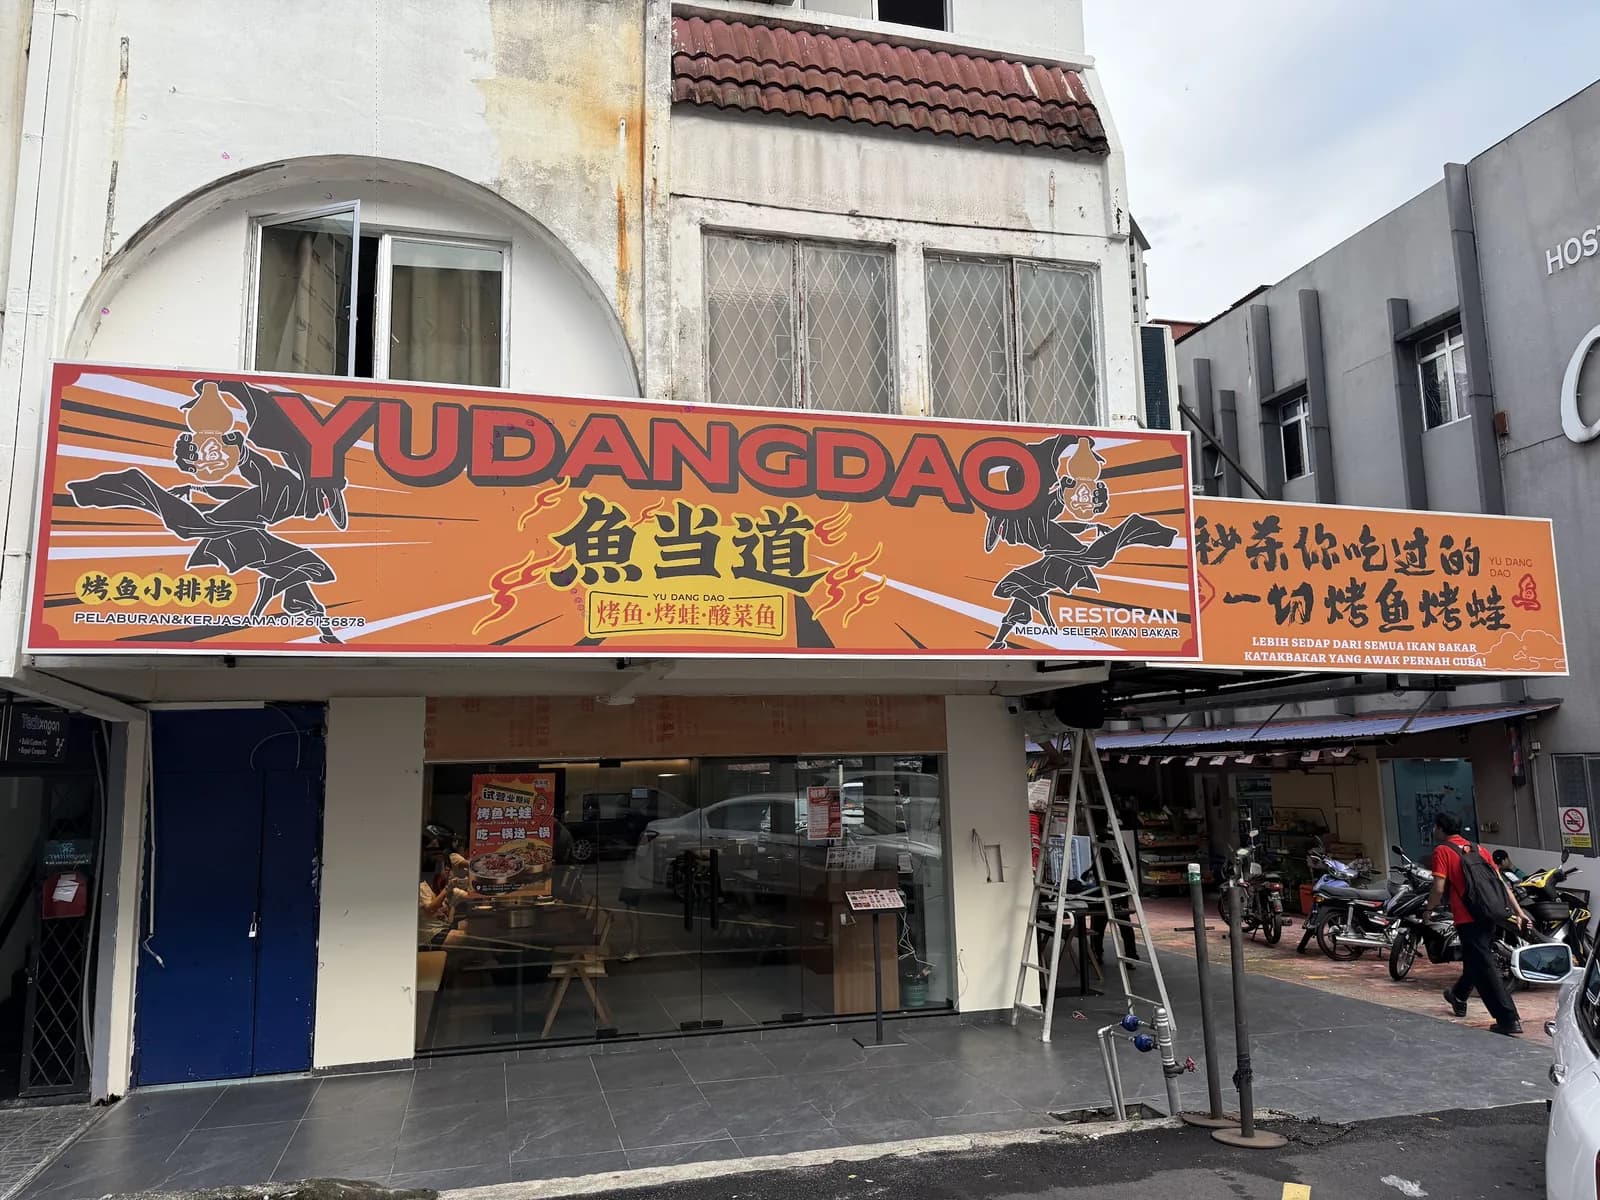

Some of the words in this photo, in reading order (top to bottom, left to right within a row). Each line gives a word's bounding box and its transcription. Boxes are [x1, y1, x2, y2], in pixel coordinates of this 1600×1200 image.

[1545, 225, 1600, 275] HOS
[271, 395, 1042, 513] YUDANGDAO
[1488, 556, 1502, 566] YU
[1504, 558, 1533, 568] DANG
[1489, 568, 1511, 578] DAO
[81, 574, 233, 602] 烤鱼小排档
[653, 593, 667, 601] YU
[670, 593, 700, 602] DANG
[703, 594, 725, 602] DAO
[1223, 576, 1511, 633] 一切烤鱼烤蛙
[74, 612, 366, 628] PELABURAN&KERJASAMA:0126136878
[1059, 606, 1178, 625] RESTORAN
[1015, 626, 1058, 636] MEDAN
[1062, 627, 1107, 638] SELERA
[1111, 628, 1137, 638] IKAN
[1141, 628, 1179, 639] BAKAR
[1252, 636, 1289, 647] LEBIH
[1291, 638, 1330, 648] SEDAP
[1333, 639, 1362, 649] DARI
[1364, 640, 1404, 651] SEMUA
[1407, 641, 1436, 652] IKAN
[1438, 642, 1477, 653] BAKAR
[1244, 651, 1327, 663] KATAKBAKAR
[1329, 653, 1362, 664] YANG
[1364, 655, 1401, 665] AWAK
[1402, 656, 1450, 666] PERNAH
[1452, 657, 1487, 667] CUBA!
[476, 826, 551, 840] 吃一锅送一锅
